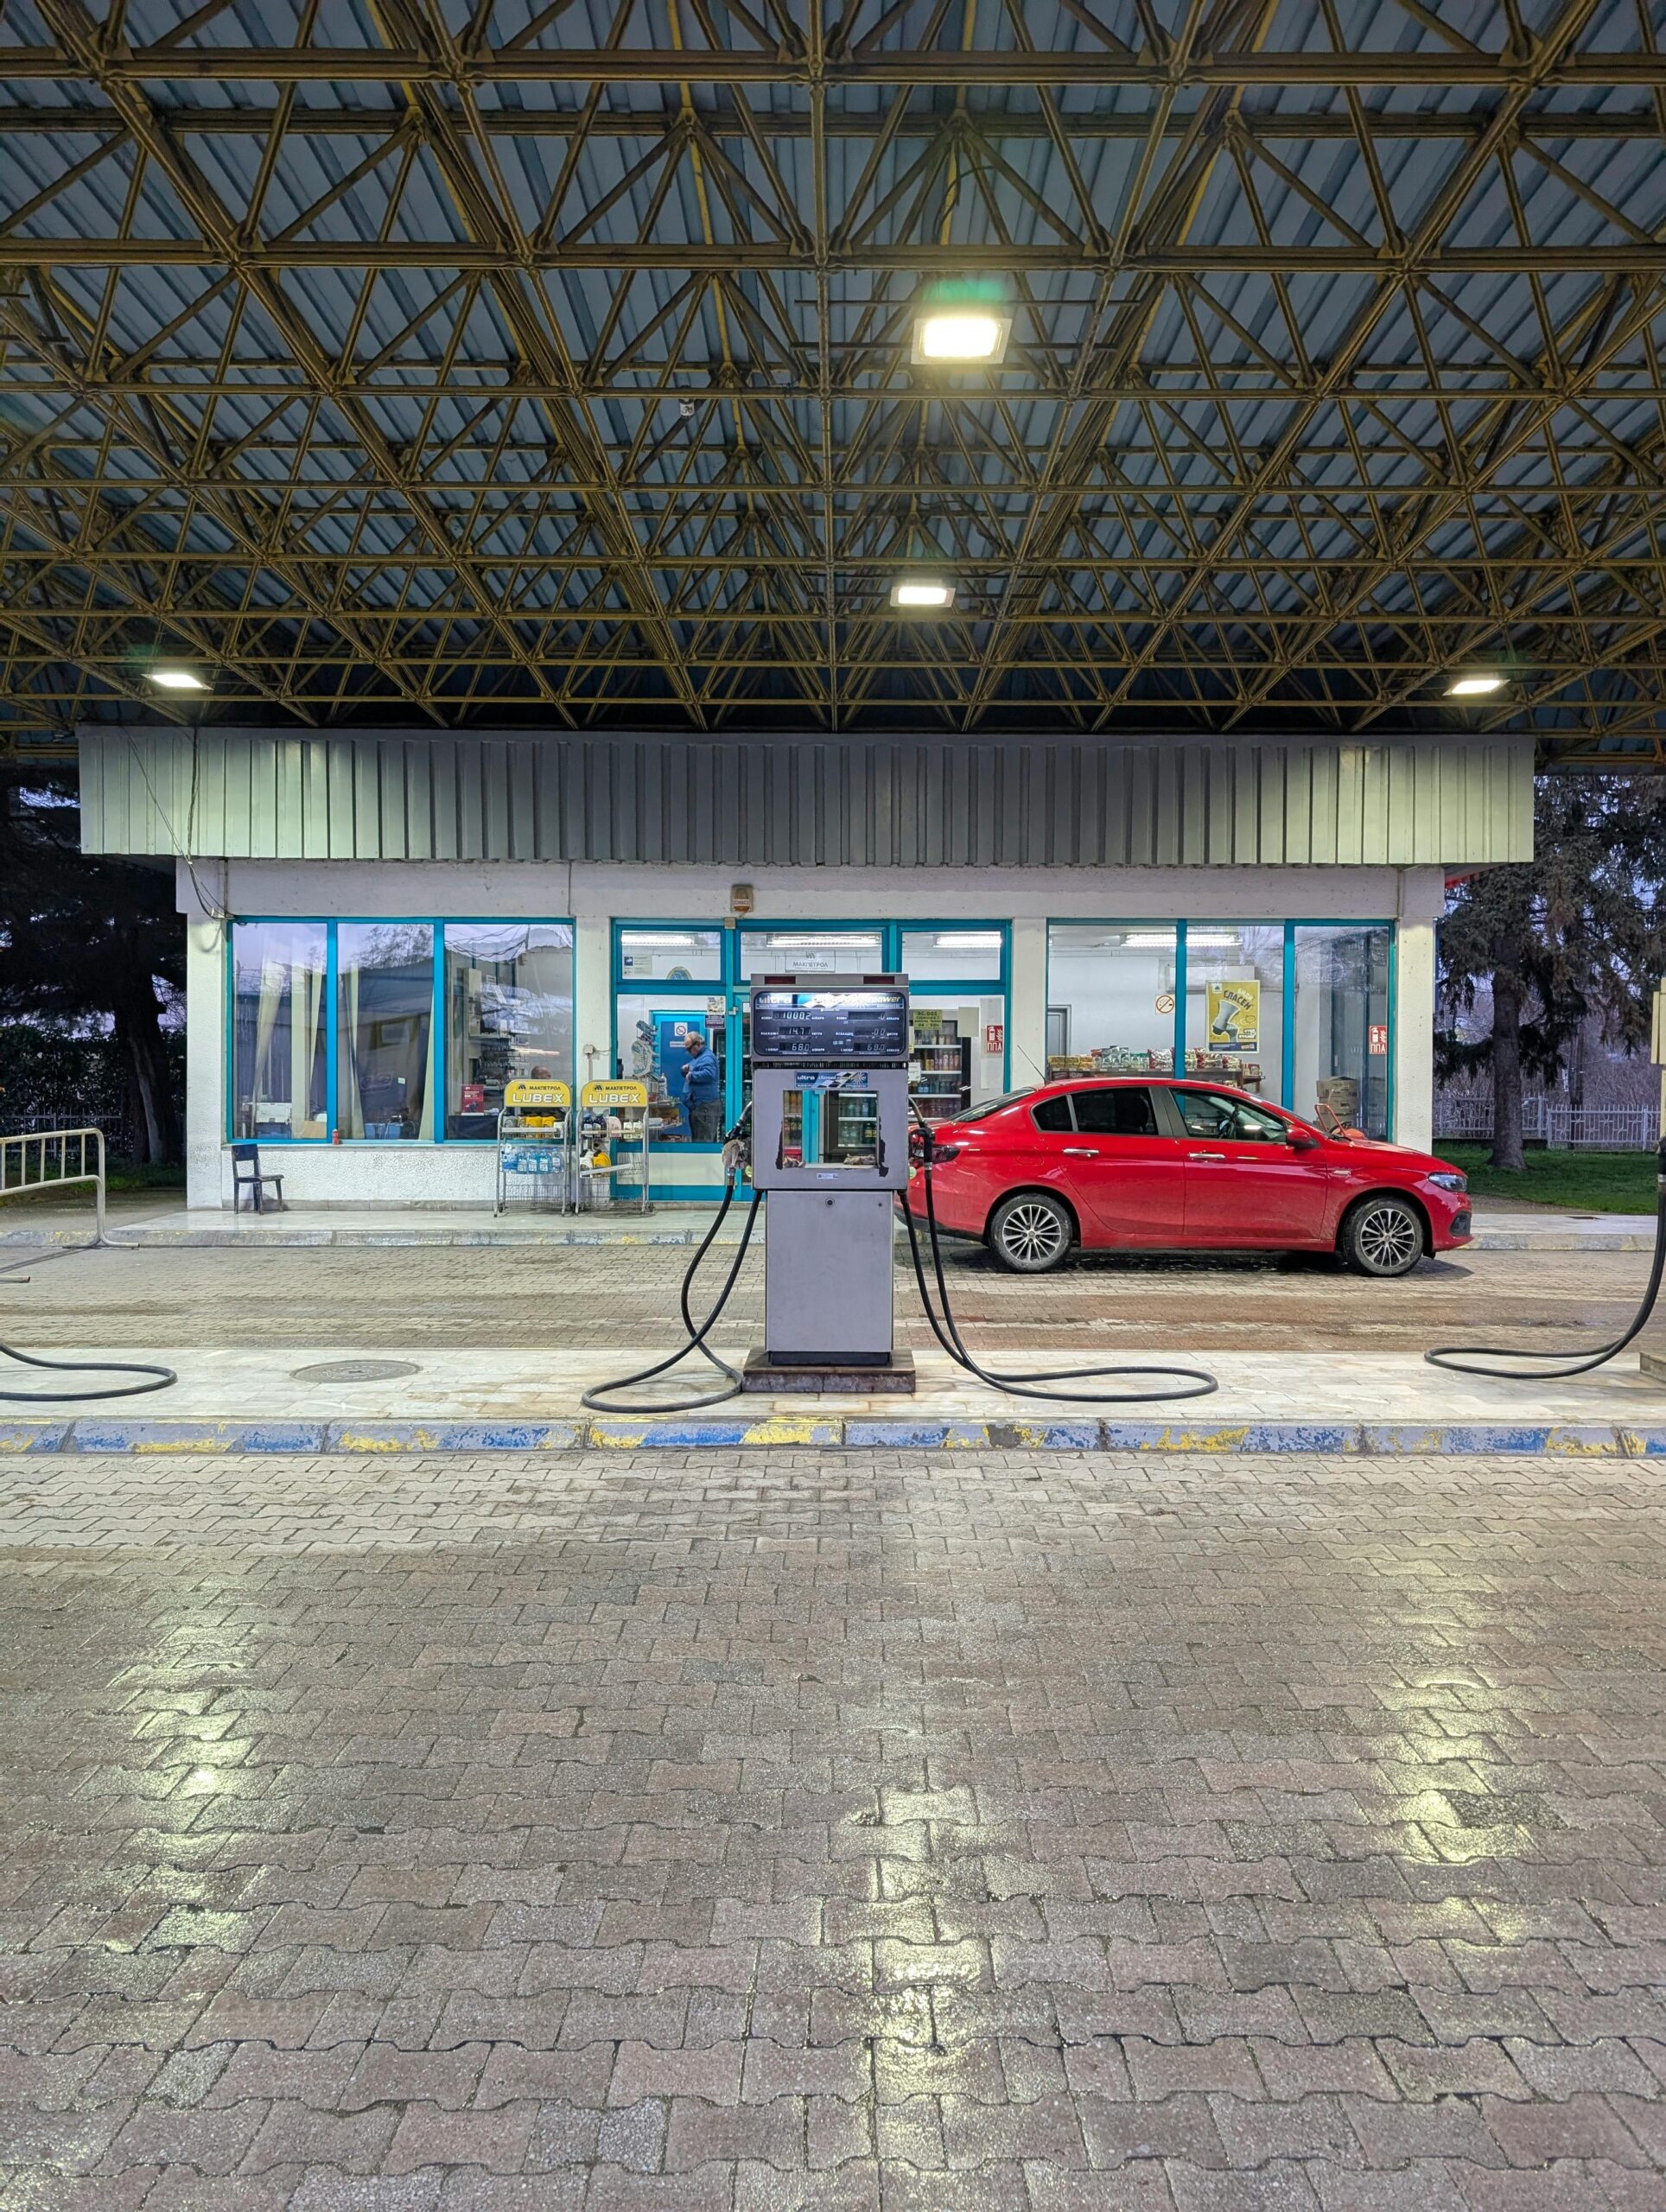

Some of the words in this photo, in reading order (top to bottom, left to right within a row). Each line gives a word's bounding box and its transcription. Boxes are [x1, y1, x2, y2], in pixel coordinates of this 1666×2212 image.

[987, 1042, 1002, 1052] ППА
[1370, 1043, 1386, 1053] ППА
[512, 1093, 564, 1103] LUBEX
[588, 1093, 640, 1103] LUBEX
